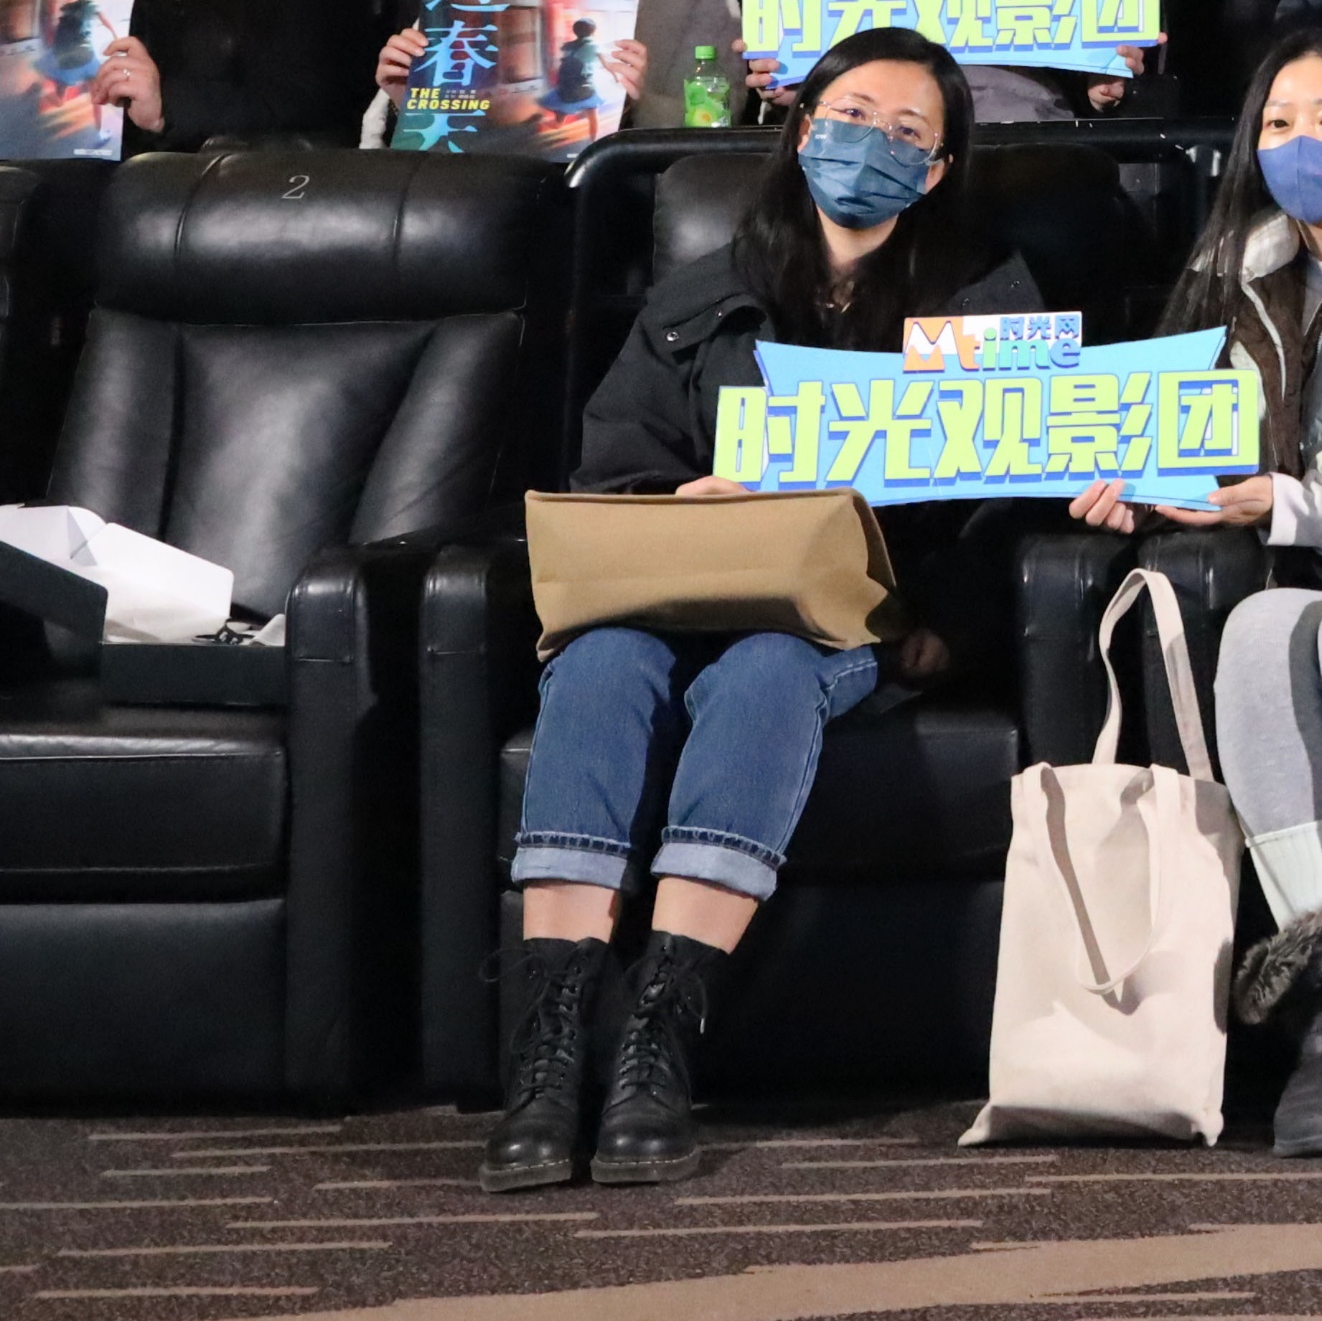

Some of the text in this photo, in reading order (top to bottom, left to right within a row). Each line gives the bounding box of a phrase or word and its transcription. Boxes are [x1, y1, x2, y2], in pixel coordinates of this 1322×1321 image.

[406, 99, 491, 111] CROSSING
[410, 88, 441, 100] THE
[280, 174, 311, 199] 2
[1000, 315, 1081, 341] 时光网
[902, 318, 1081, 372] Mtime
[713, 368, 1260, 488] 时光观影团
